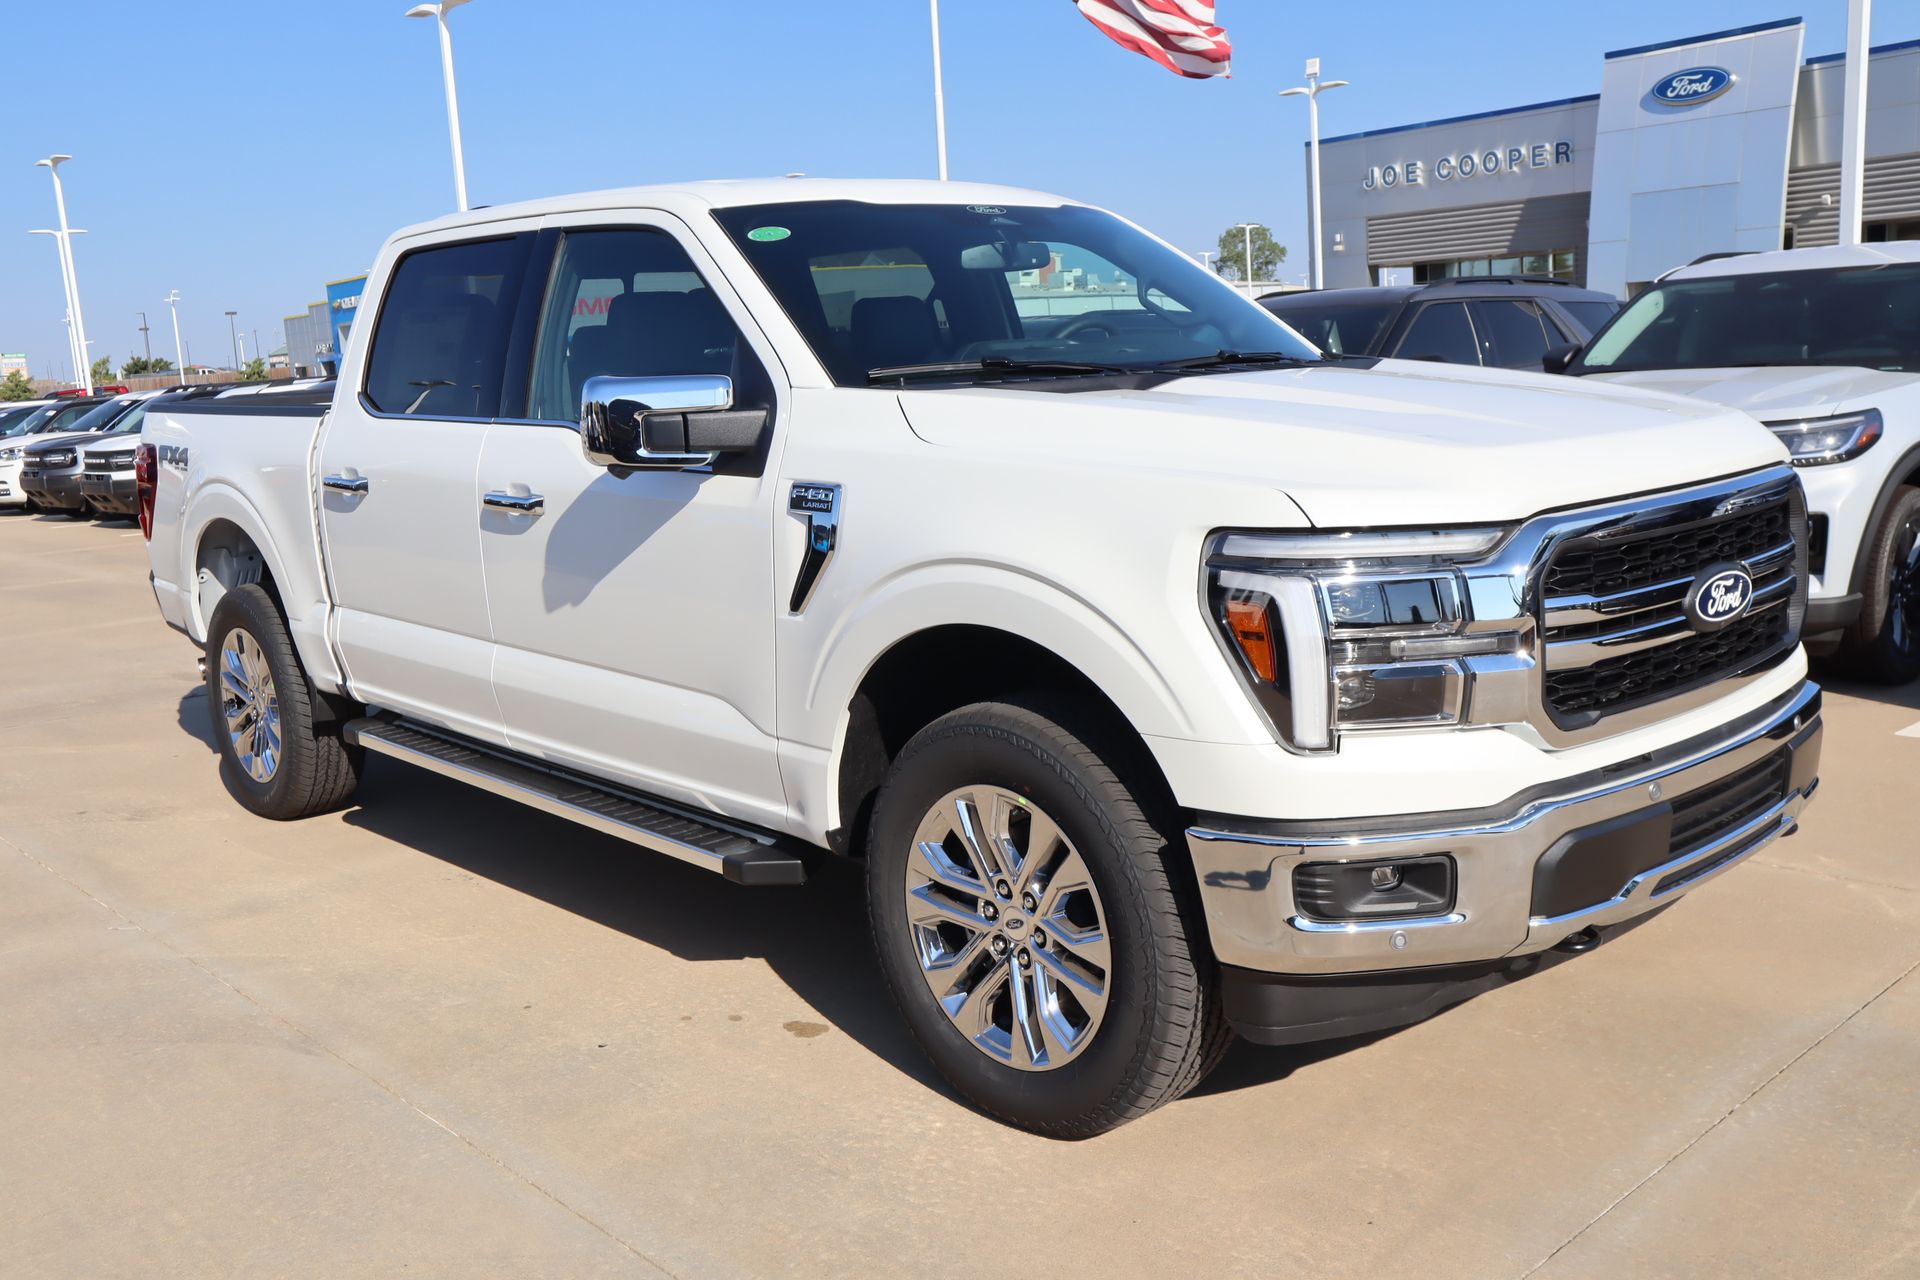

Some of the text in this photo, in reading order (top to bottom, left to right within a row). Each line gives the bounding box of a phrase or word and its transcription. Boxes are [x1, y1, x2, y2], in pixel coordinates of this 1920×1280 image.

[1665, 73, 1715, 98] Ford
[1362, 140, 1574, 191] JOE COOPER
[158, 444, 189, 467] FX4
[791, 487, 834, 501] F-150
[802, 501, 828, 509] LARIAT
[1707, 577, 1743, 616] Ford
[1008, 919, 1021, 929] Ford
